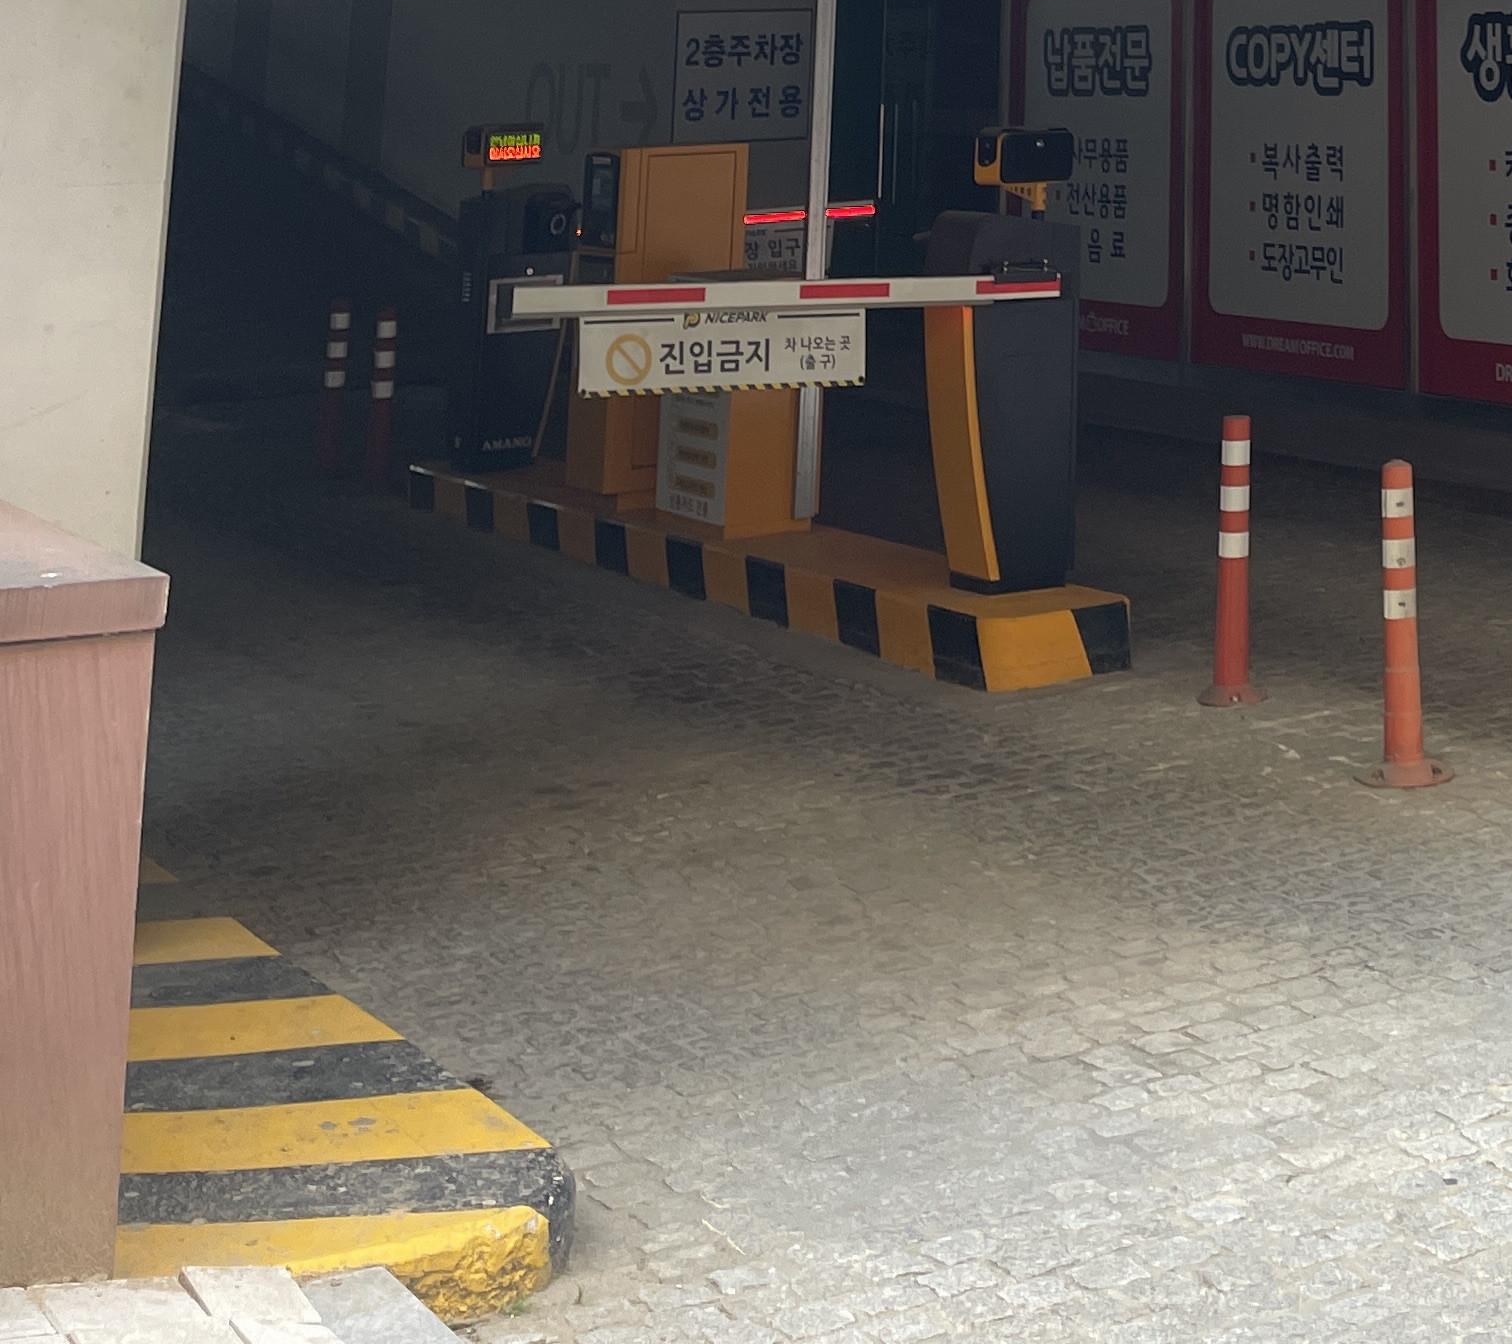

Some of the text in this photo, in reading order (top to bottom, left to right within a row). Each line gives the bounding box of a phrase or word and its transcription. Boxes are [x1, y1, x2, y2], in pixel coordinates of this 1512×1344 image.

[685, 32, 804, 68] 2층주차장
[1046, 28, 1150, 93] 납품전문
[1228, 24, 1372, 92] COPY센터
[1261, 142, 1345, 183] 복사출력
[1066, 182, 1128, 220] 전산용품
[1261, 190, 1345, 231] 명함인쇄
[1261, 241, 1344, 285] 도장고무인
[704, 311, 770, 325] NICEPARK
[659, 337, 771, 375] 진입금지
[800, 336, 836, 352] 나오는
[839, 335, 852, 351] 곳
